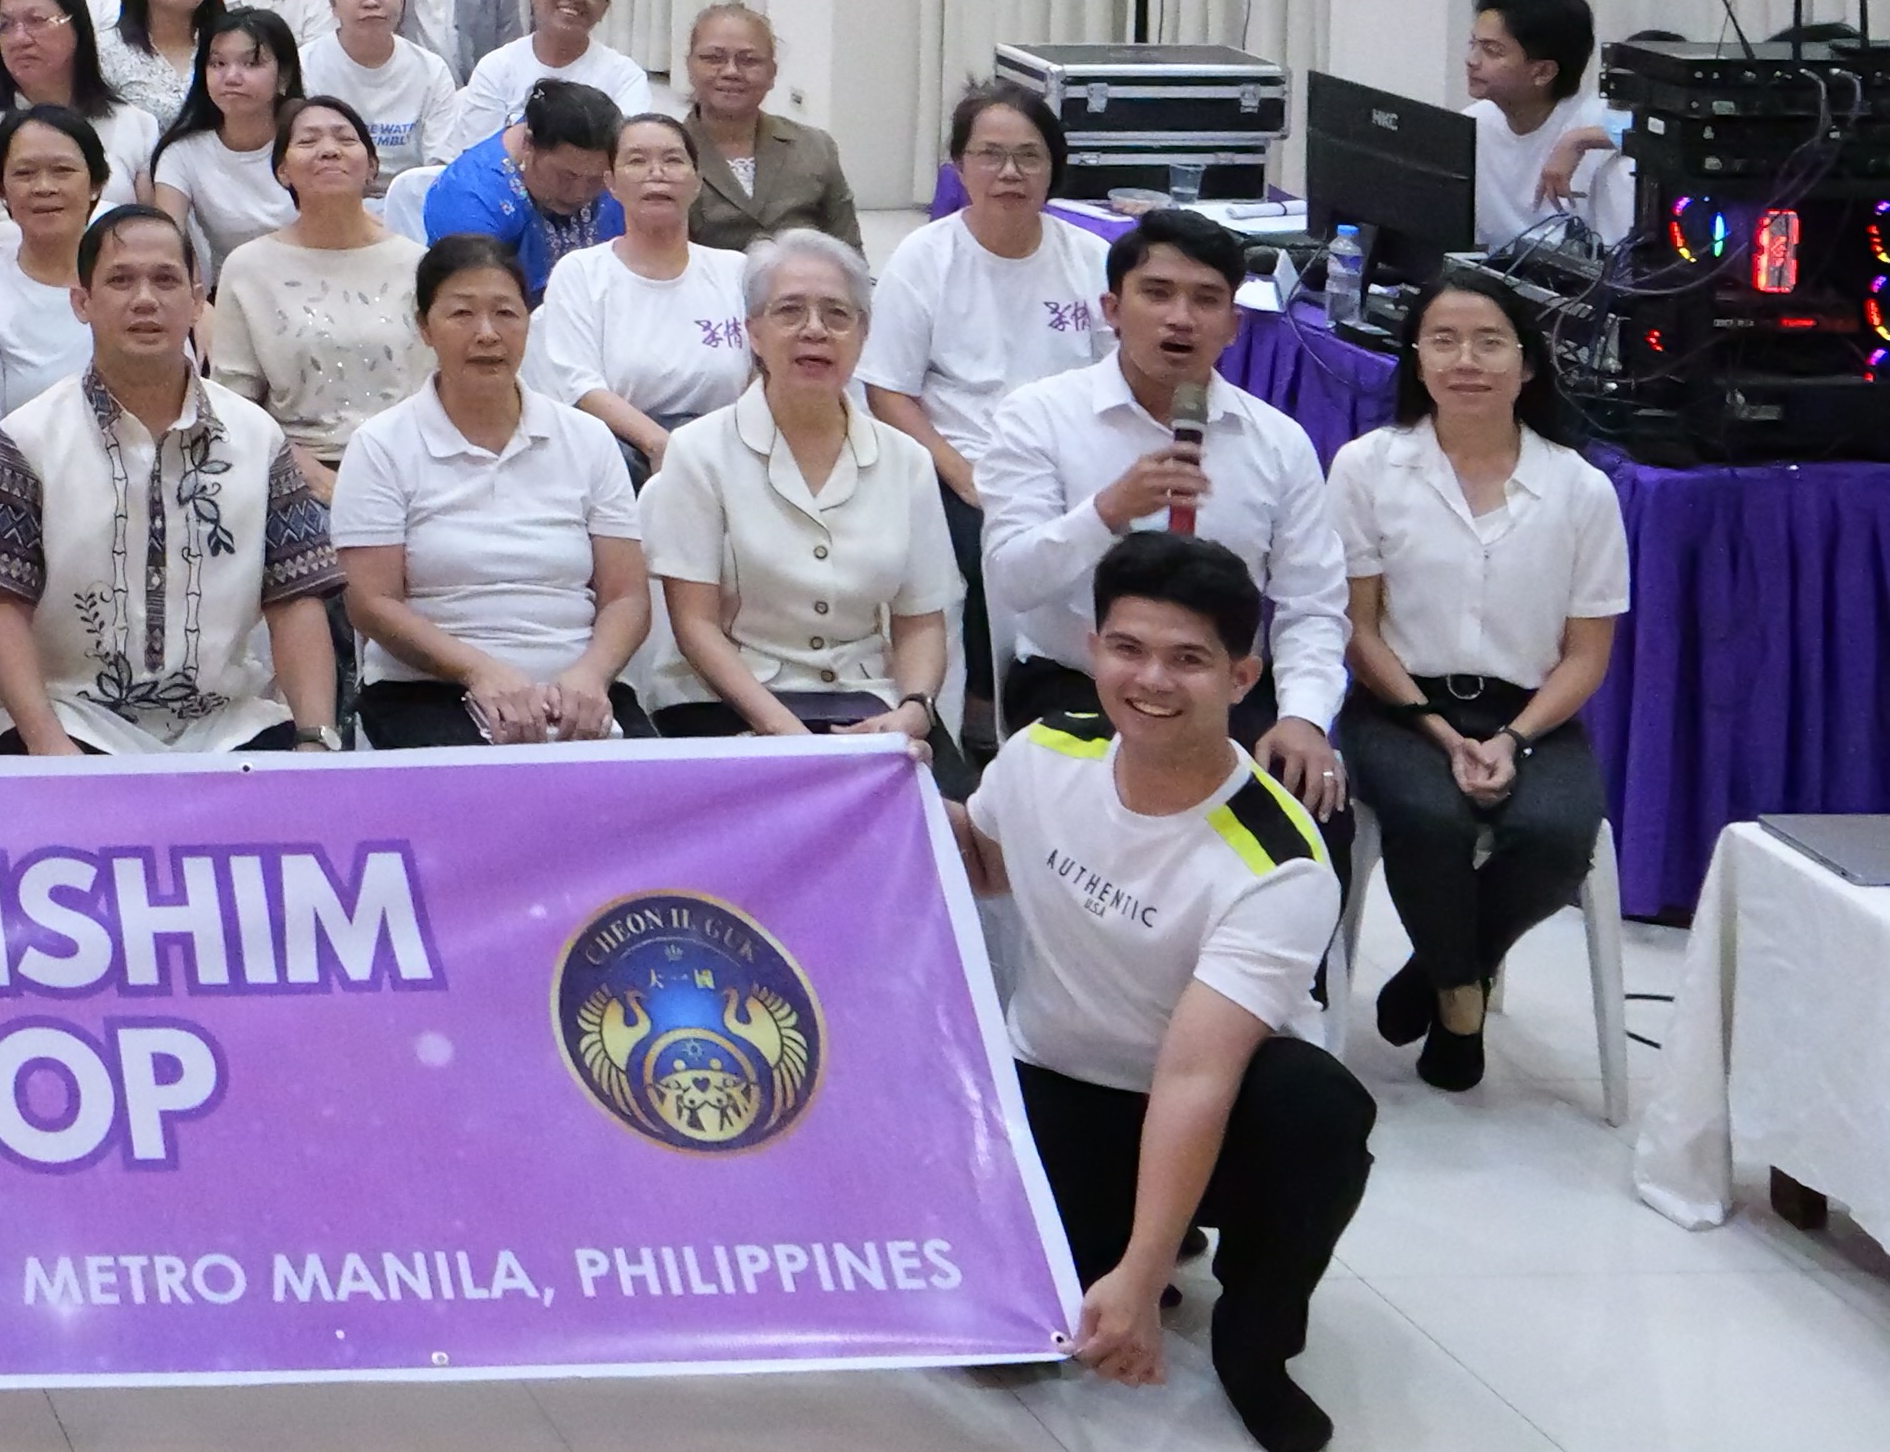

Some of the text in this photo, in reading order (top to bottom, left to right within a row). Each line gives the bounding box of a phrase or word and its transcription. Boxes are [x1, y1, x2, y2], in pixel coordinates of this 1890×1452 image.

[1372, 108, 1399, 131] HKC
[585, 908, 663, 966] CHEON
[24, 1252, 247, 1307] METRO
[272, 1248, 555, 1308] MANILA,
[576, 1238, 962, 1299] PHILIPPINES
